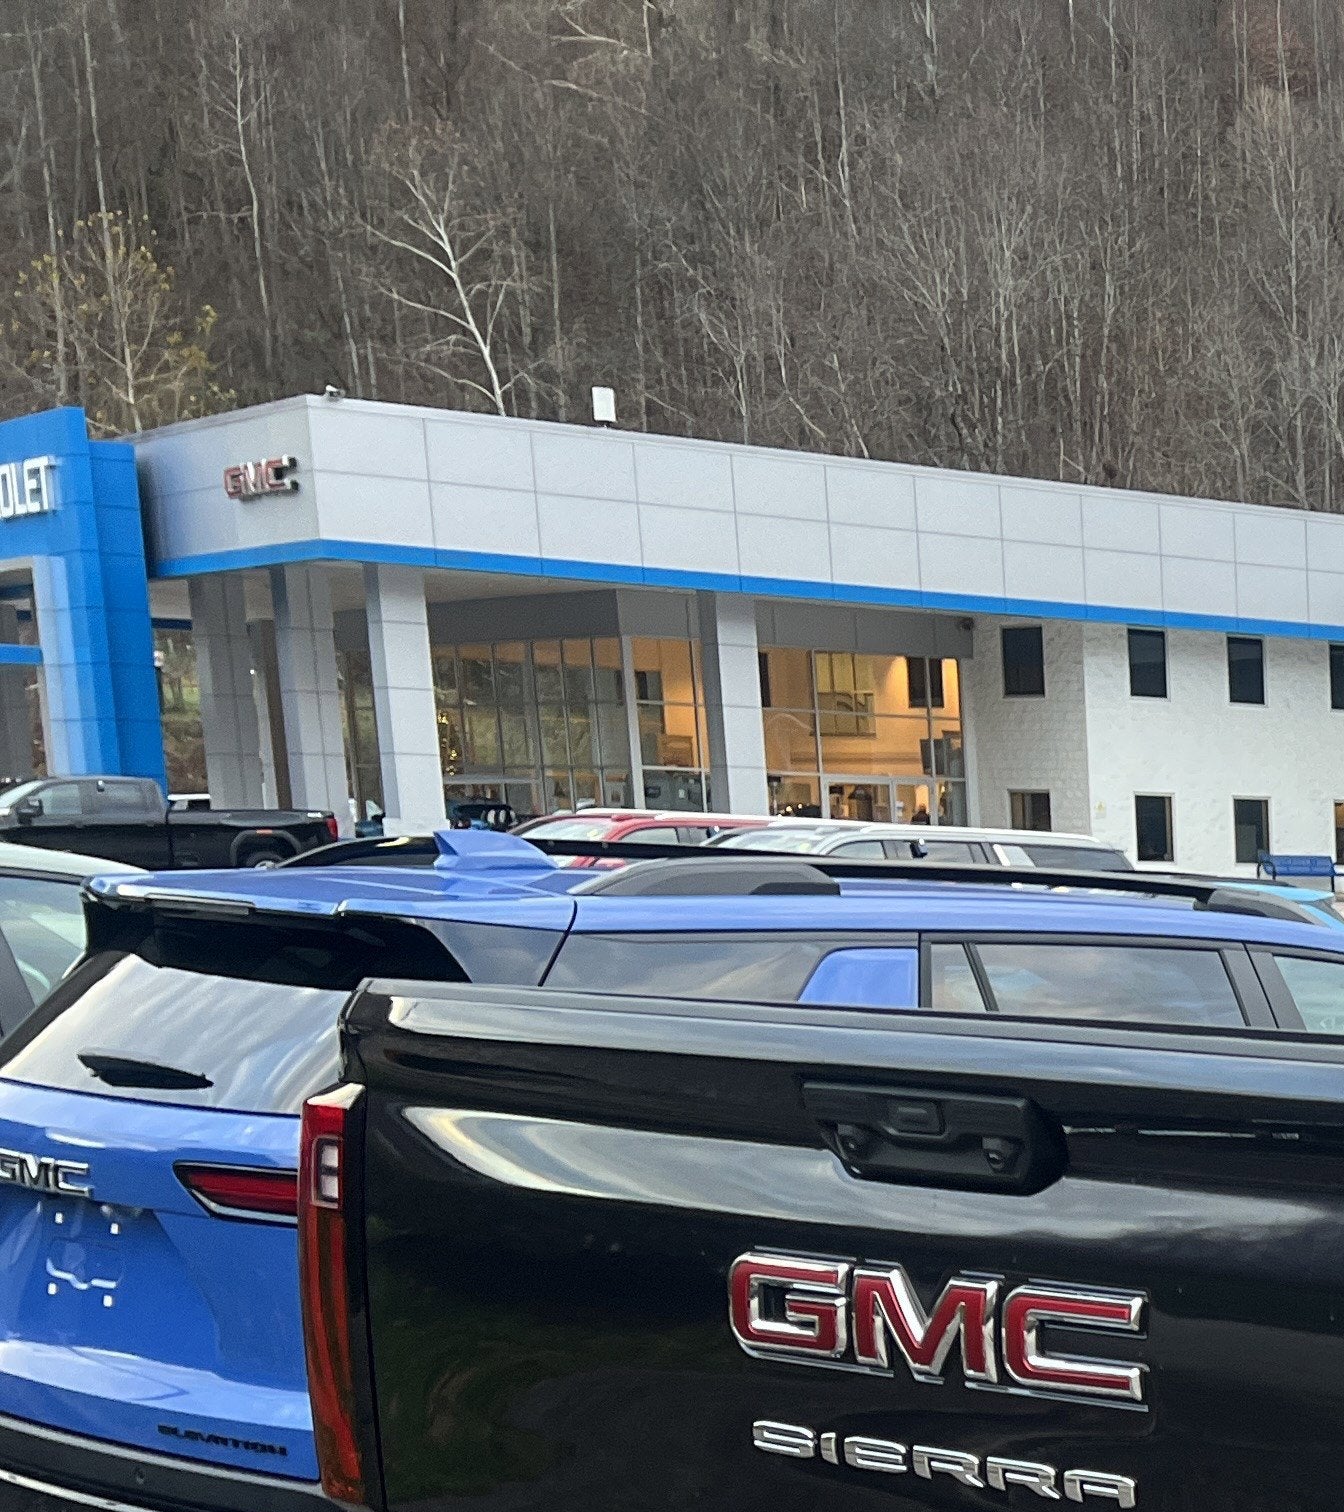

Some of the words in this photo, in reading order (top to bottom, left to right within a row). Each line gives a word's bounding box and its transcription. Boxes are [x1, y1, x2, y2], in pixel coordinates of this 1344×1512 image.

[224, 454, 299, 500] GMC
[728, 1246, 1149, 1411] GMC
[753, 1420, 1136, 1508] SIERRA
